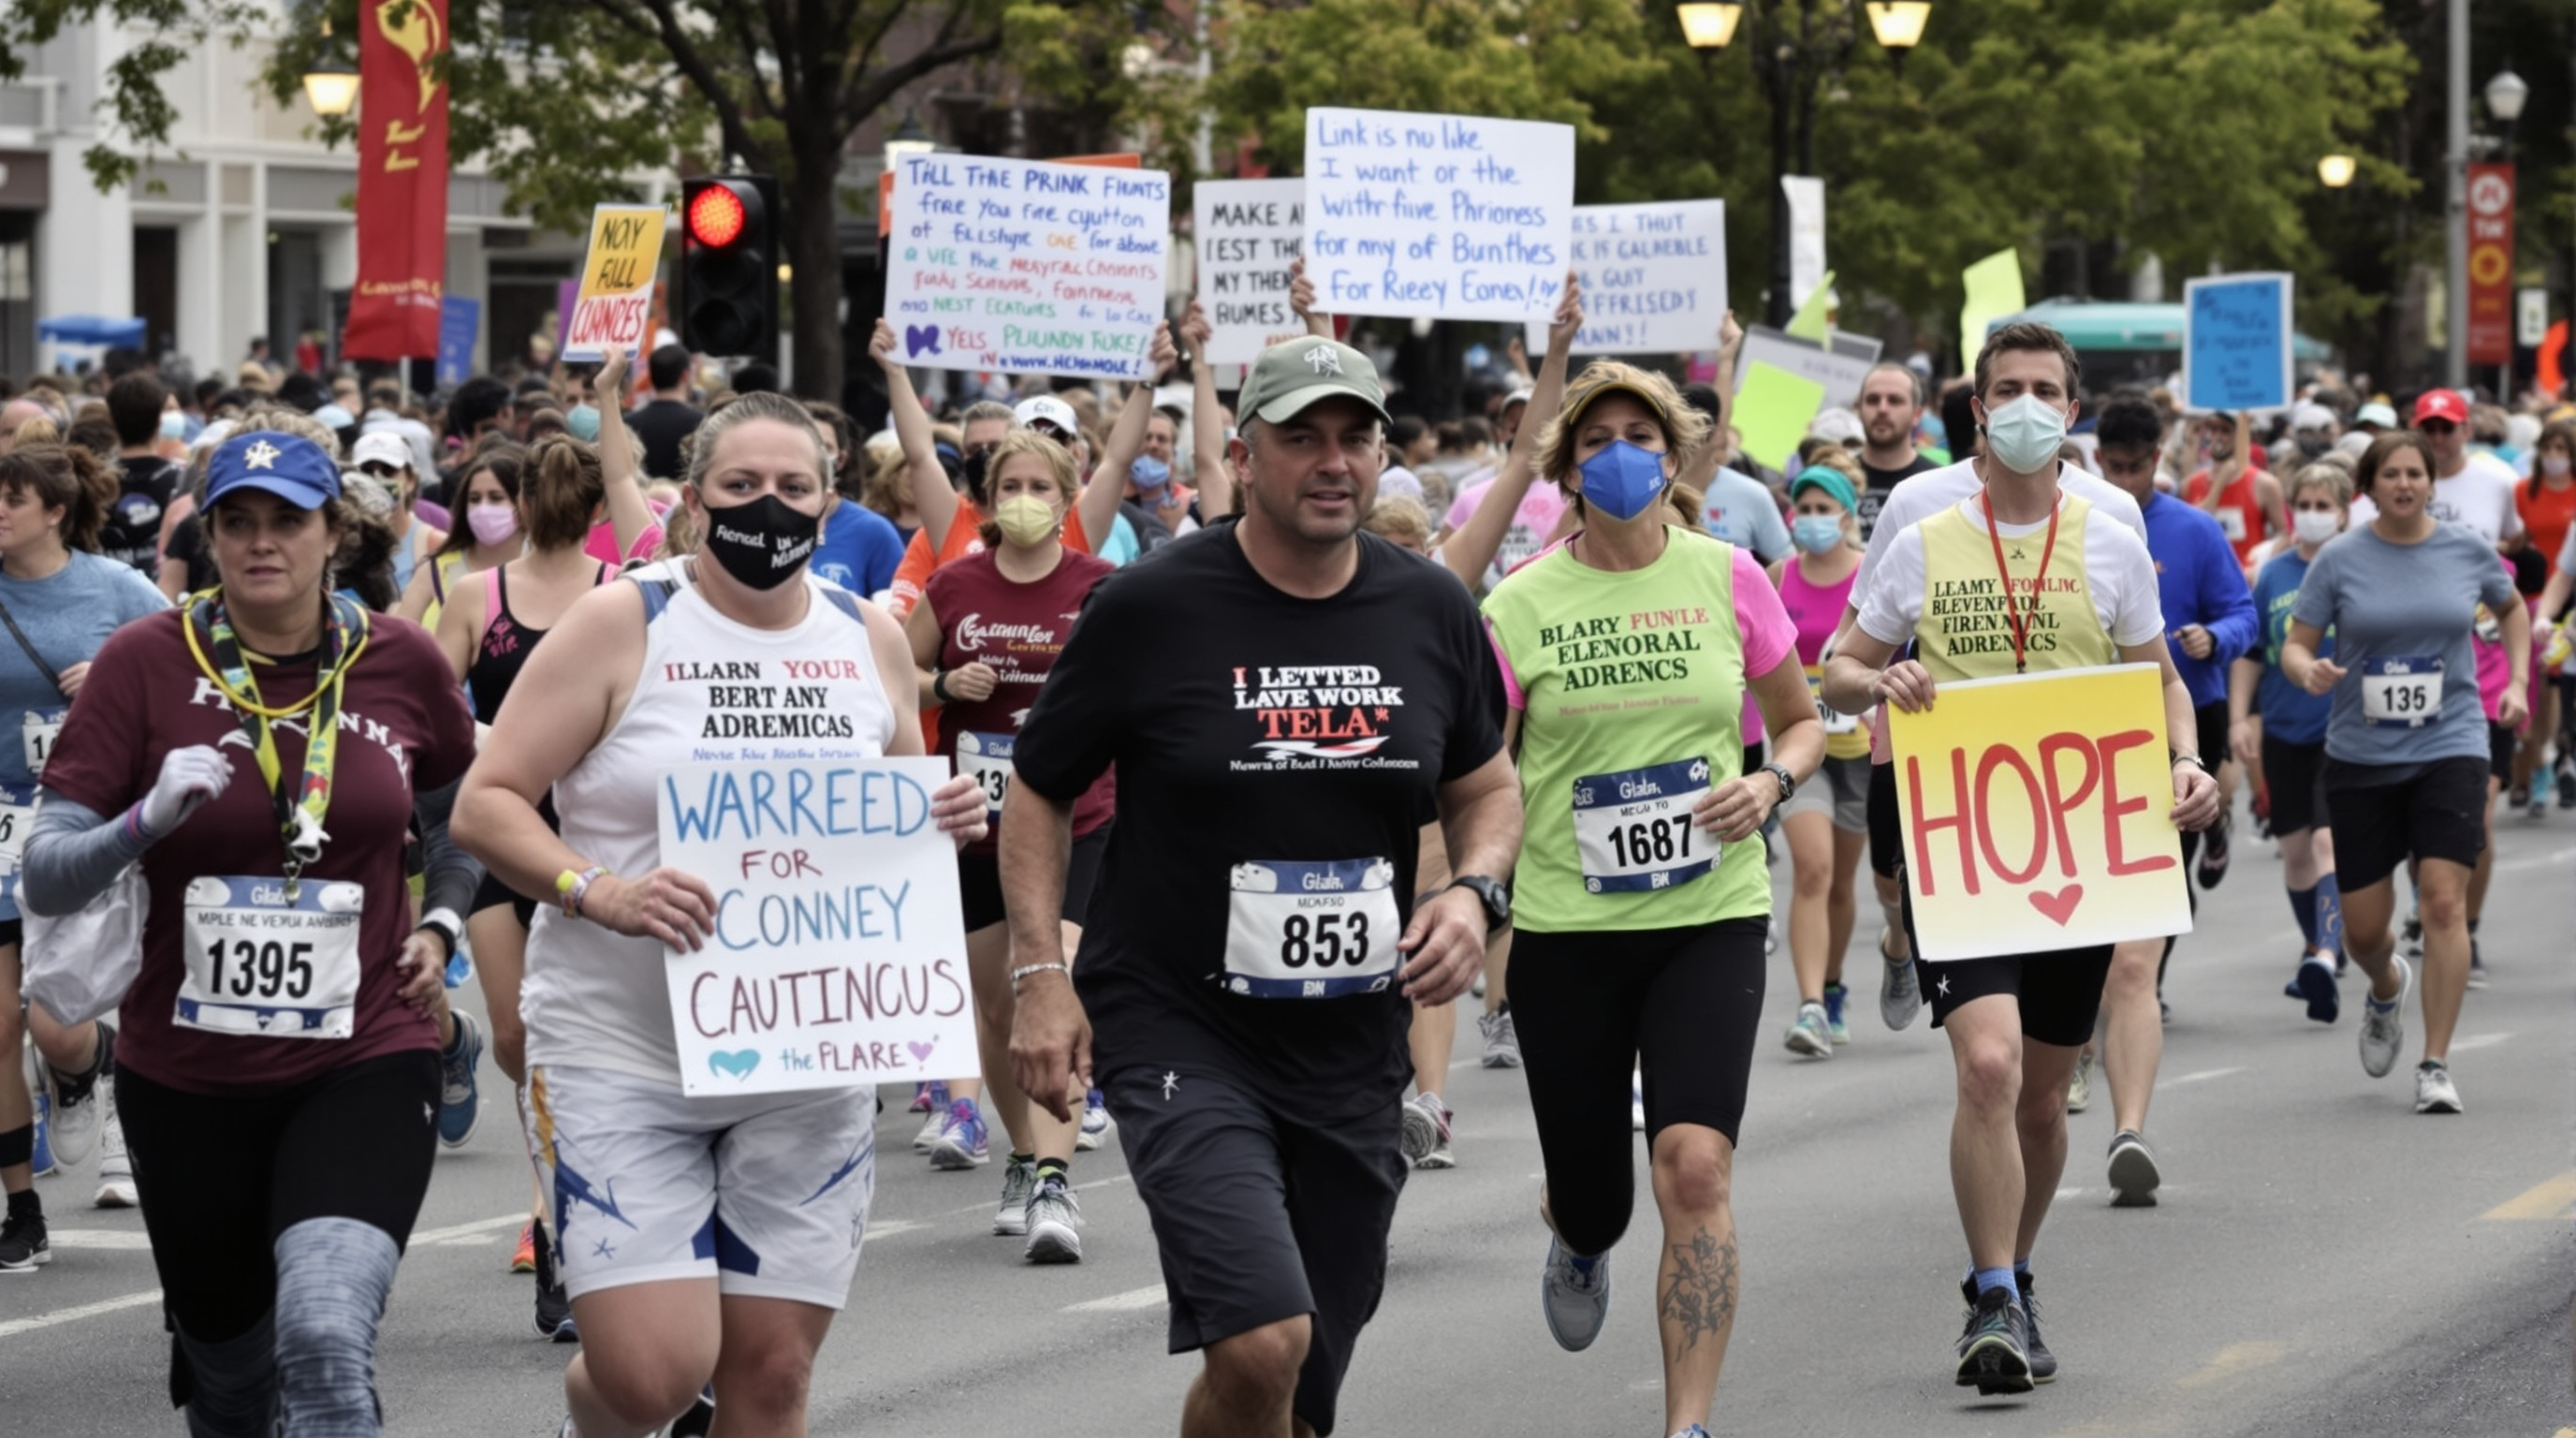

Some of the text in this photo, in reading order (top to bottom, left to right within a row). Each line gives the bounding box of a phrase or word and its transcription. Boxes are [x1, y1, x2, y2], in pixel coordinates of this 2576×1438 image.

[1317, 116, 1368, 148] Link
[1376, 124, 1397, 147] is
[1442, 120, 1483, 151] like
[1024, 169, 1089, 195] PRINK
[1320, 157, 1340, 178] I
[1355, 158, 1420, 183] want
[1472, 154, 1520, 184] the
[1211, 202, 1305, 227] MAKE A
[1409, 233, 1439, 260] of
[1214, 271, 1240, 294] MY
[1934, 579, 1997, 597] LEAMY
[1540, 616, 1620, 648] BLARY
[1557, 630, 1701, 666] ELENORAL
[665, 660, 861, 682] ILLARN YOUR
[1258, 665, 1381, 688] LETTED
[1563, 657, 1689, 692] ADRENCS
[709, 685, 828, 709] BERT ANY
[1235, 687, 1404, 710] LAVE WORK
[2382, 685, 2425, 712] 135
[701, 714, 854, 738] ADREMICAS
[975, 770, 1009, 802] 13
[666, 769, 929, 843] WARREED
[1907, 729, 2176, 896] HOPE
[1608, 813, 1692, 867] 1687
[741, 848, 823, 880] FOR
[716, 879, 910, 951] CONNEY
[1281, 911, 1368, 968] 853
[208, 938, 313, 999] 1395
[780, 1048, 813, 1071] the
